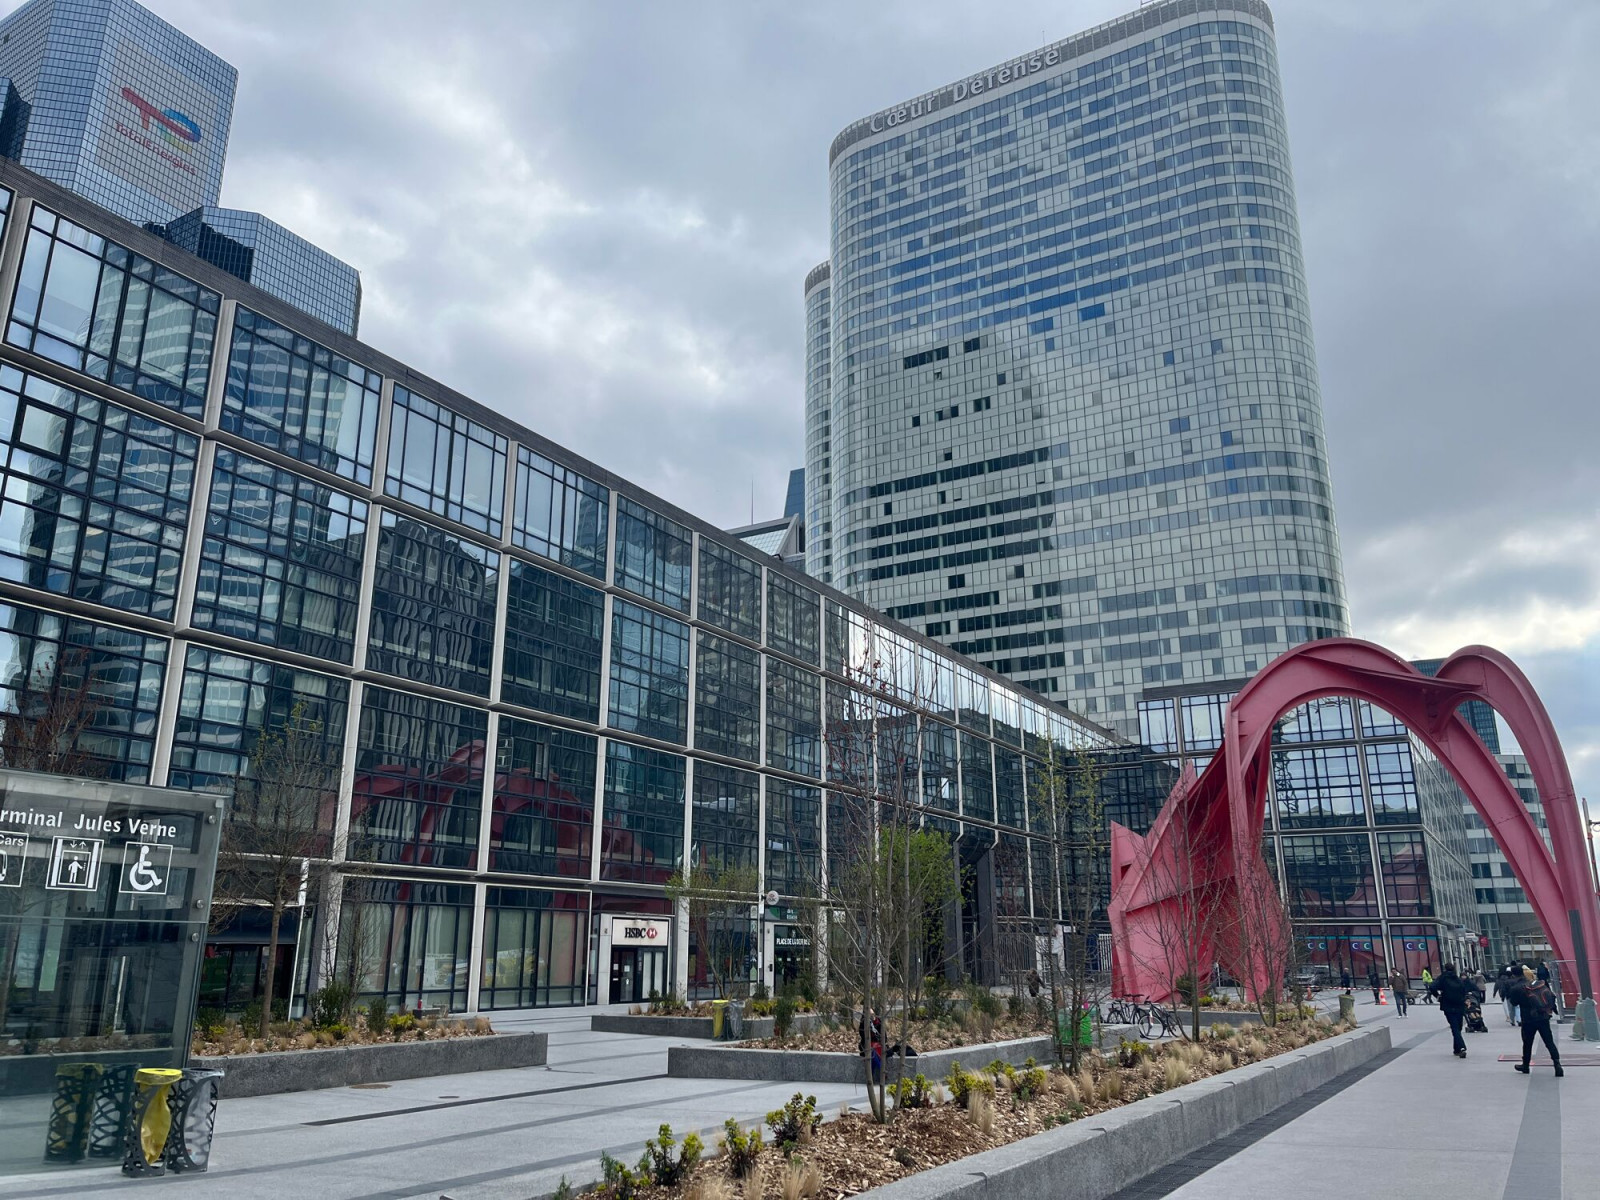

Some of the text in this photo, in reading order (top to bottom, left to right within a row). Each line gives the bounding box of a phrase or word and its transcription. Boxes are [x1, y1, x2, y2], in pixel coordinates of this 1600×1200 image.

[869, 48, 1060, 133] Cœur Défense
[115, 121, 197, 176] TotalEnergies
[74, 813, 122, 833] Jules
[128, 818, 177, 838] Verne
[624, 927, 647, 939] HSBC
